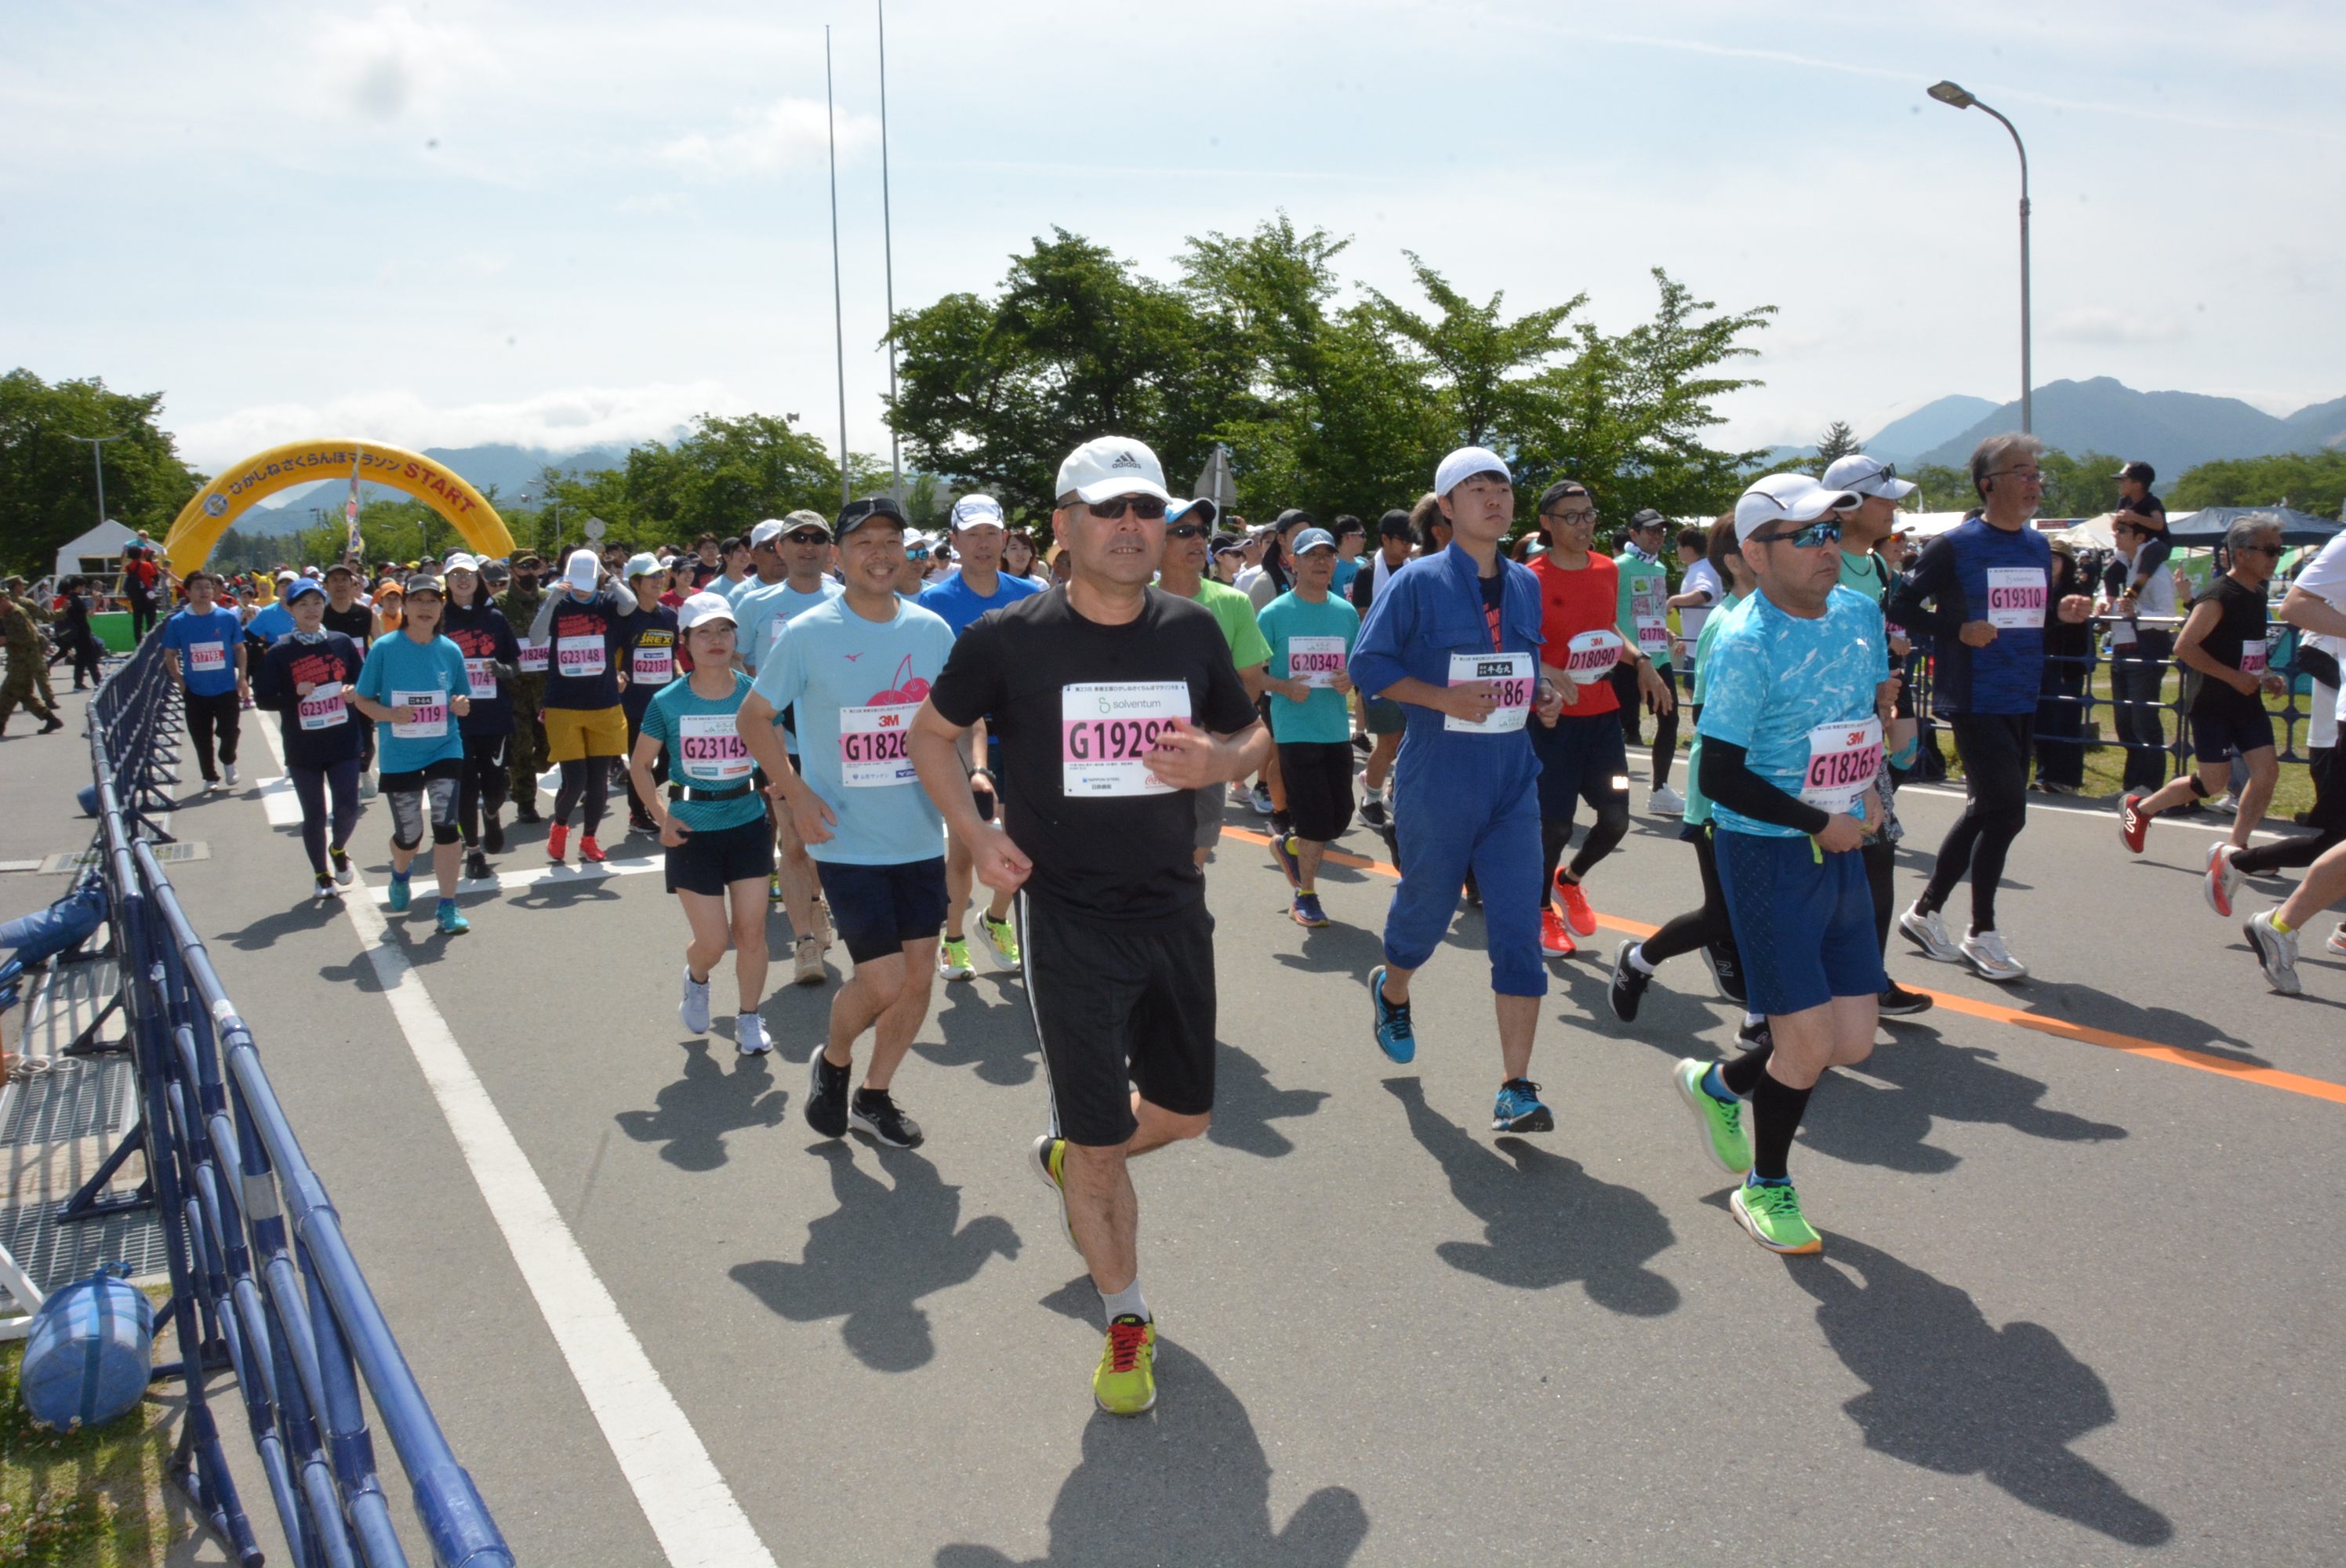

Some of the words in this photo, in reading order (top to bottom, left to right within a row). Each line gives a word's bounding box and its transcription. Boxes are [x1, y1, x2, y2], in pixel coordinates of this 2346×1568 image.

[228, 452, 400, 495] ひがしねさくらんぼマラソン
[404, 461, 476, 514] START
[1992, 588, 2040, 608] G19310
[1590, 637, 1603, 647] 3M
[1640, 628, 1666, 641] G1719
[523, 648, 548, 661] 18246
[561, 649, 600, 664] G23148
[1291, 654, 1338, 671] G20342
[1569, 648, 1615, 670] D18090
[635, 660, 667, 672] G22137
[471, 672, 490, 686] 174
[1494, 680, 1523, 706] 186
[300, 696, 338, 717] G23147
[1113, 699, 1160, 709] solventum
[878, 714, 899, 728] 3M
[846, 731, 908, 760] G1826
[1847, 731, 1865, 746] 3M
[685, 737, 747, 759] G23145
[1810, 746, 1876, 786] G18265
